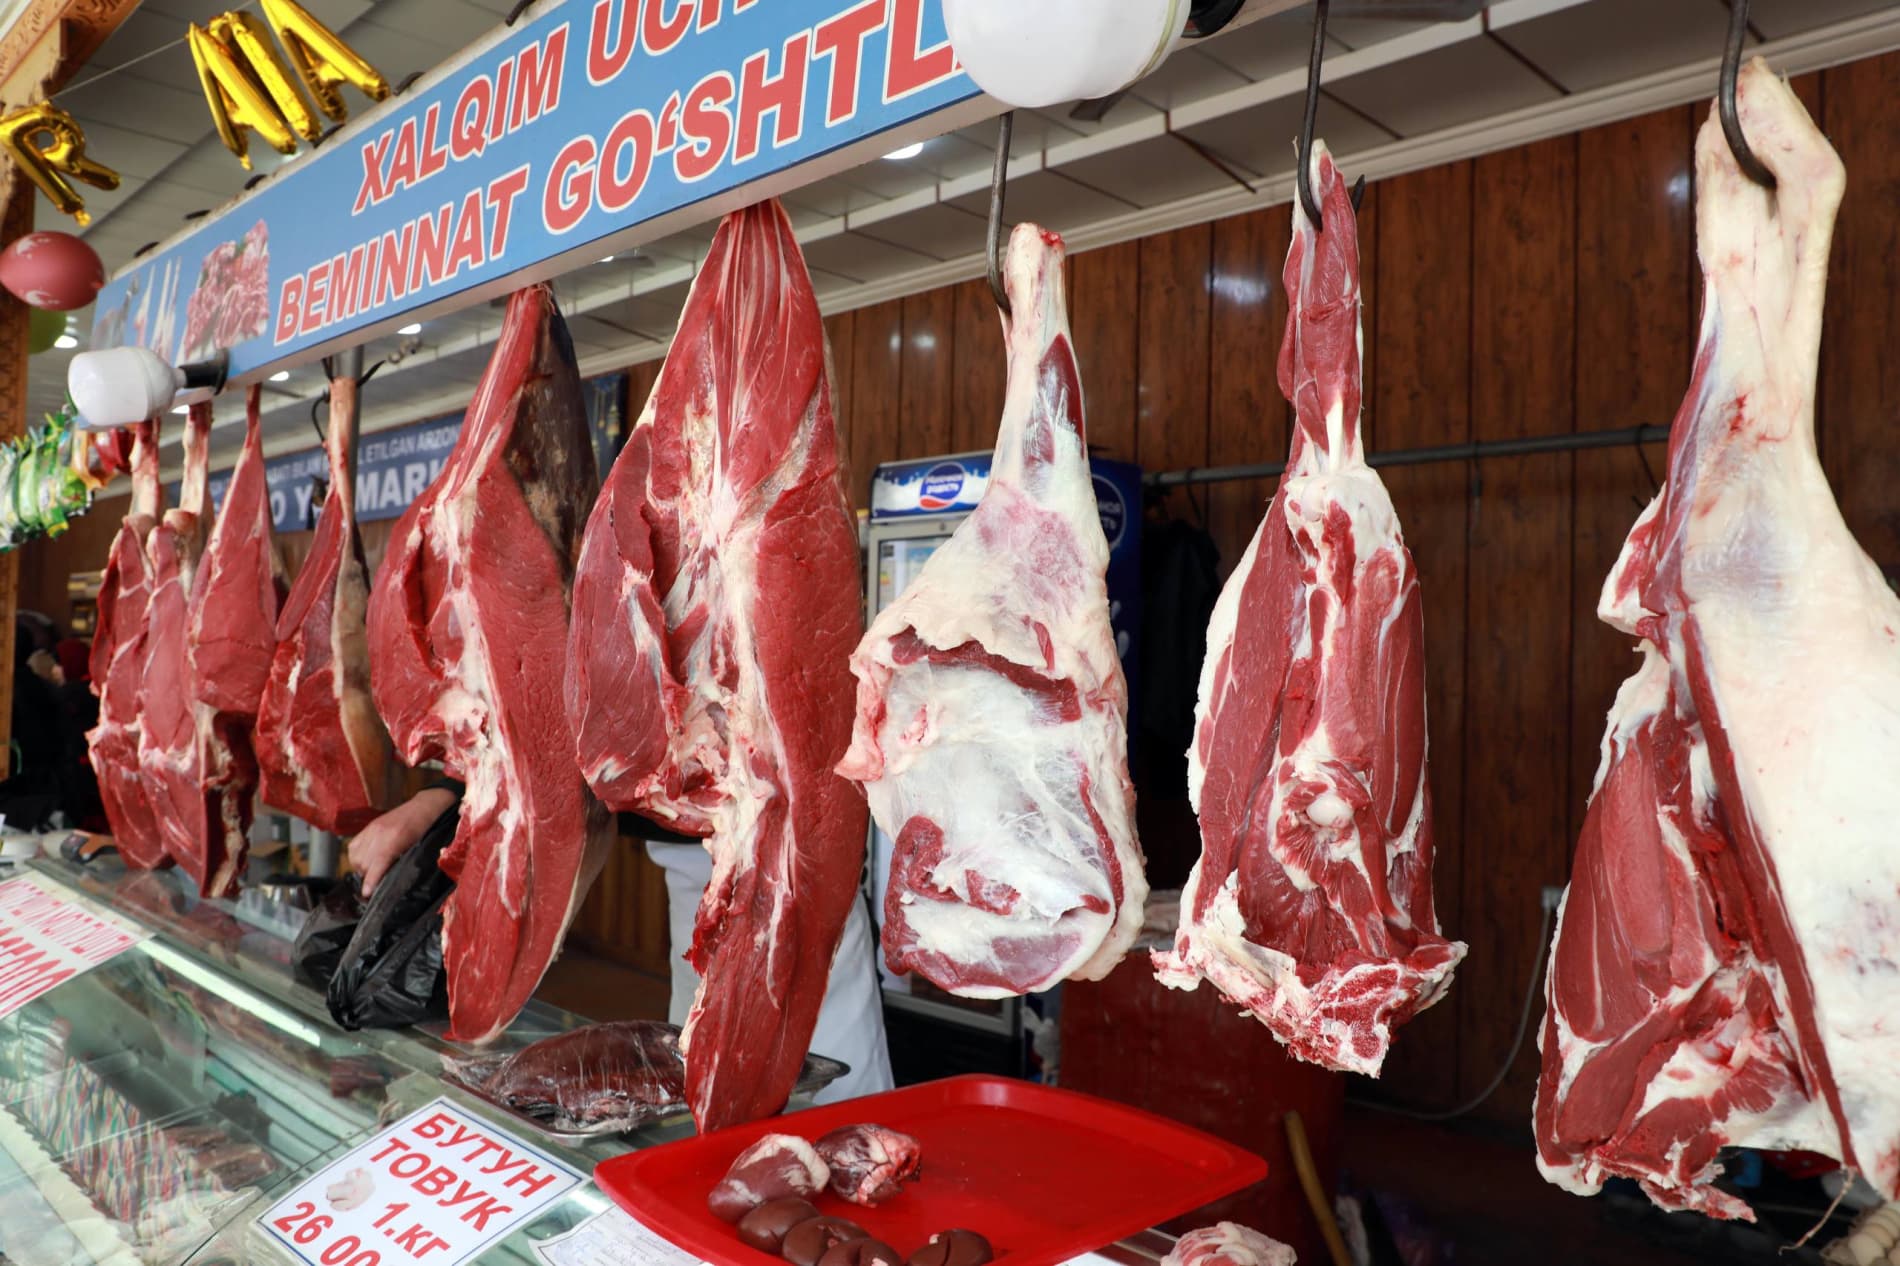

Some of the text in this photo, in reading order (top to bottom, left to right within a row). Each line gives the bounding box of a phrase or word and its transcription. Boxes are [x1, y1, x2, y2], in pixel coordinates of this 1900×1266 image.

[351, 0, 760, 216] XALQIM UC
[274, 163, 530, 346] BEMINNAT
[370, 1136, 513, 1233] ТОВУК
[411, 1112, 556, 1198] БУТУН
[273, 1201, 334, 1245] 26
